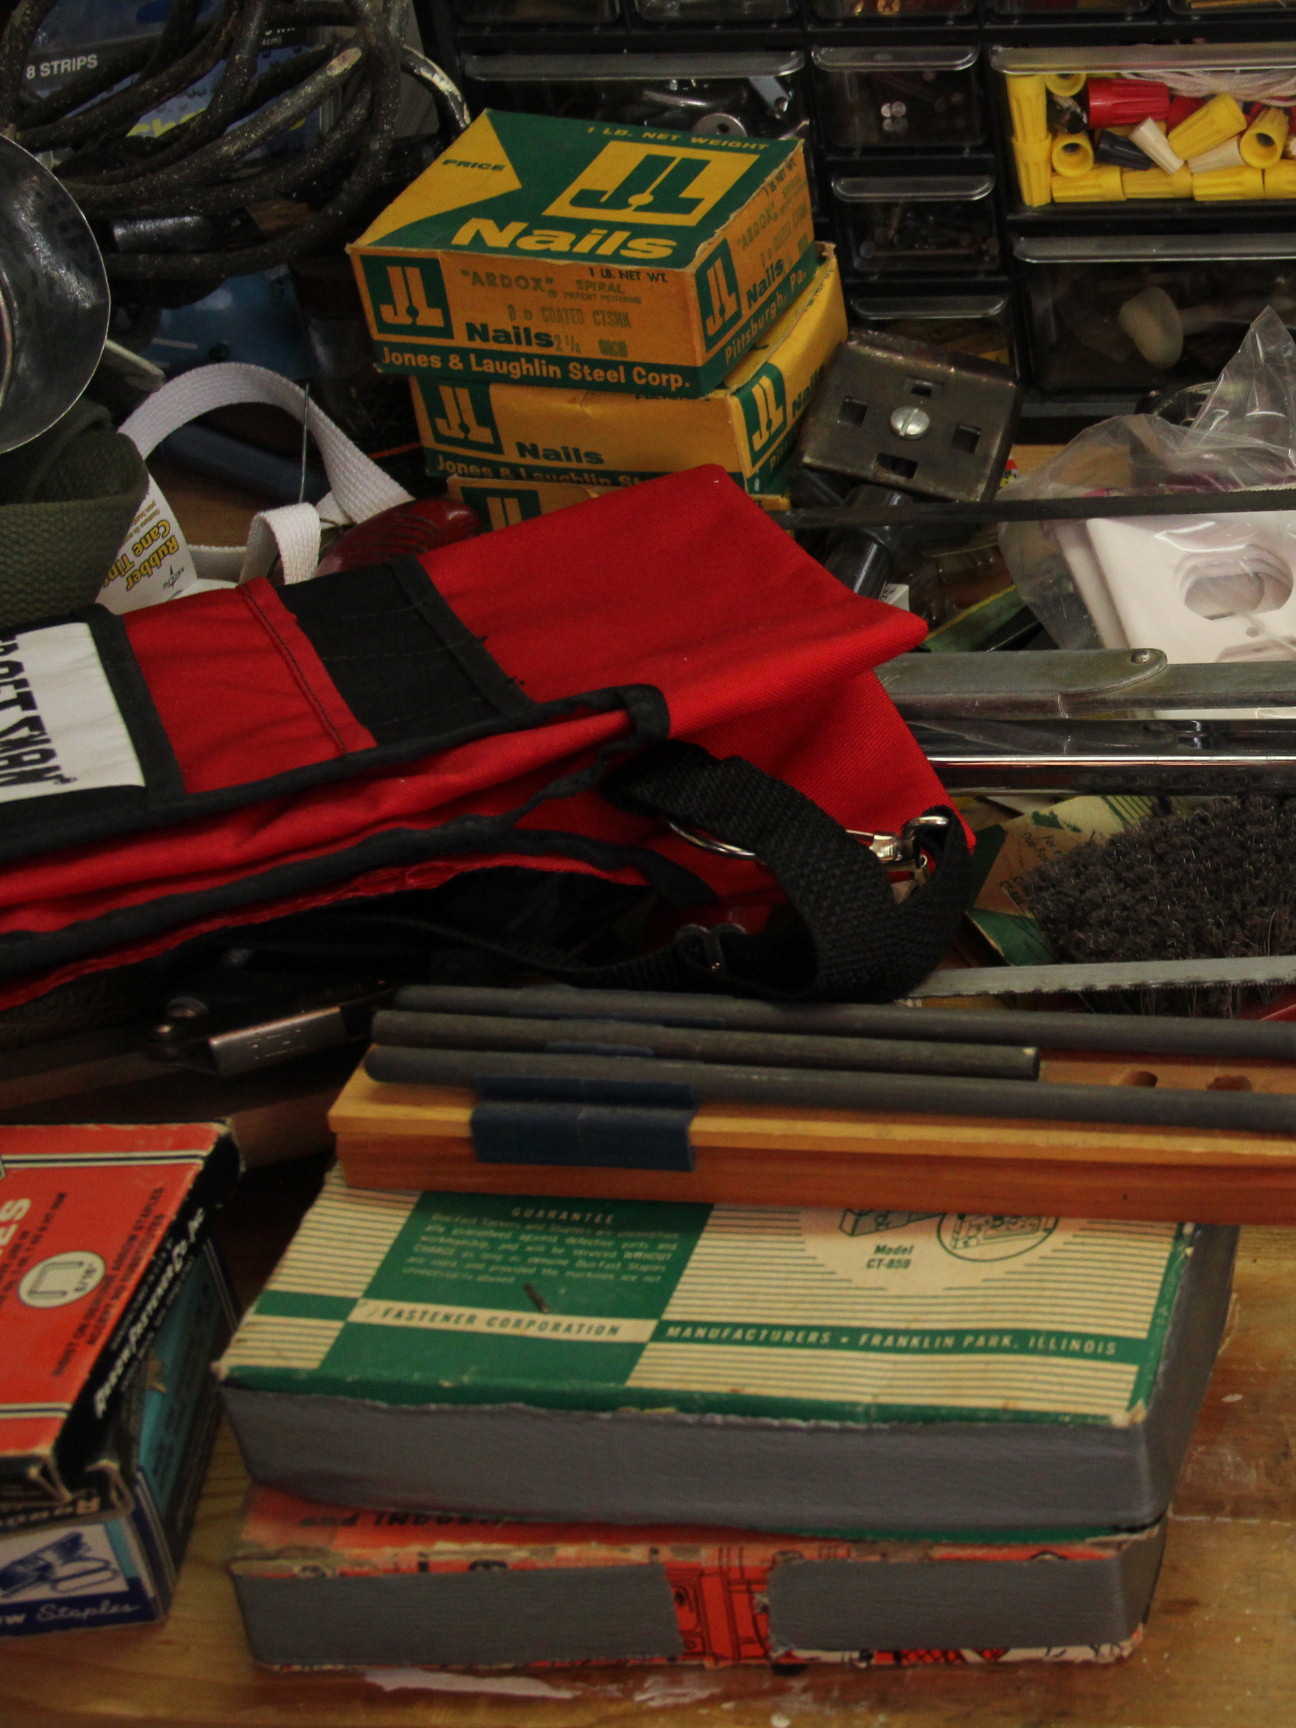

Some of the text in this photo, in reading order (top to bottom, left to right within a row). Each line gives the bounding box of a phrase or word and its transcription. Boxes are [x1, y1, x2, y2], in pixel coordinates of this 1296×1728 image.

[26, 54, 98, 80] 8 STRIPS
[599, 127, 633, 138] LB.
[643, 131, 680, 142] NET
[689, 136, 770, 152] WEIGHT
[442, 157, 506, 171] PRICE
[451, 217, 677, 259] Nails
[576, 279, 625, 294] SPIRAL
[746, 258, 785, 310] Nails
[790, 270, 807, 292] Pa.
[465, 322, 554, 348] Nails
[380, 347, 691, 393] Jones & Laughlin Steel Corp.
[515, 441, 605, 464] Nails
[437, 455, 494, 479] Jones
[131, 519, 171, 557] Cane
[125, 535, 179, 591] Rubber
[511, 1207, 615, 1224] GUARANTEE
[873, 1245, 914, 1255] Model
[381, 1308, 620, 1336] FASTENER CORPORATION
[666, 1326, 833, 1345] MANUFACTURERS
[858, 1333, 954, 1350] FRANKLIN
[1028, 1335, 1118, 1356] ILLINOIS
